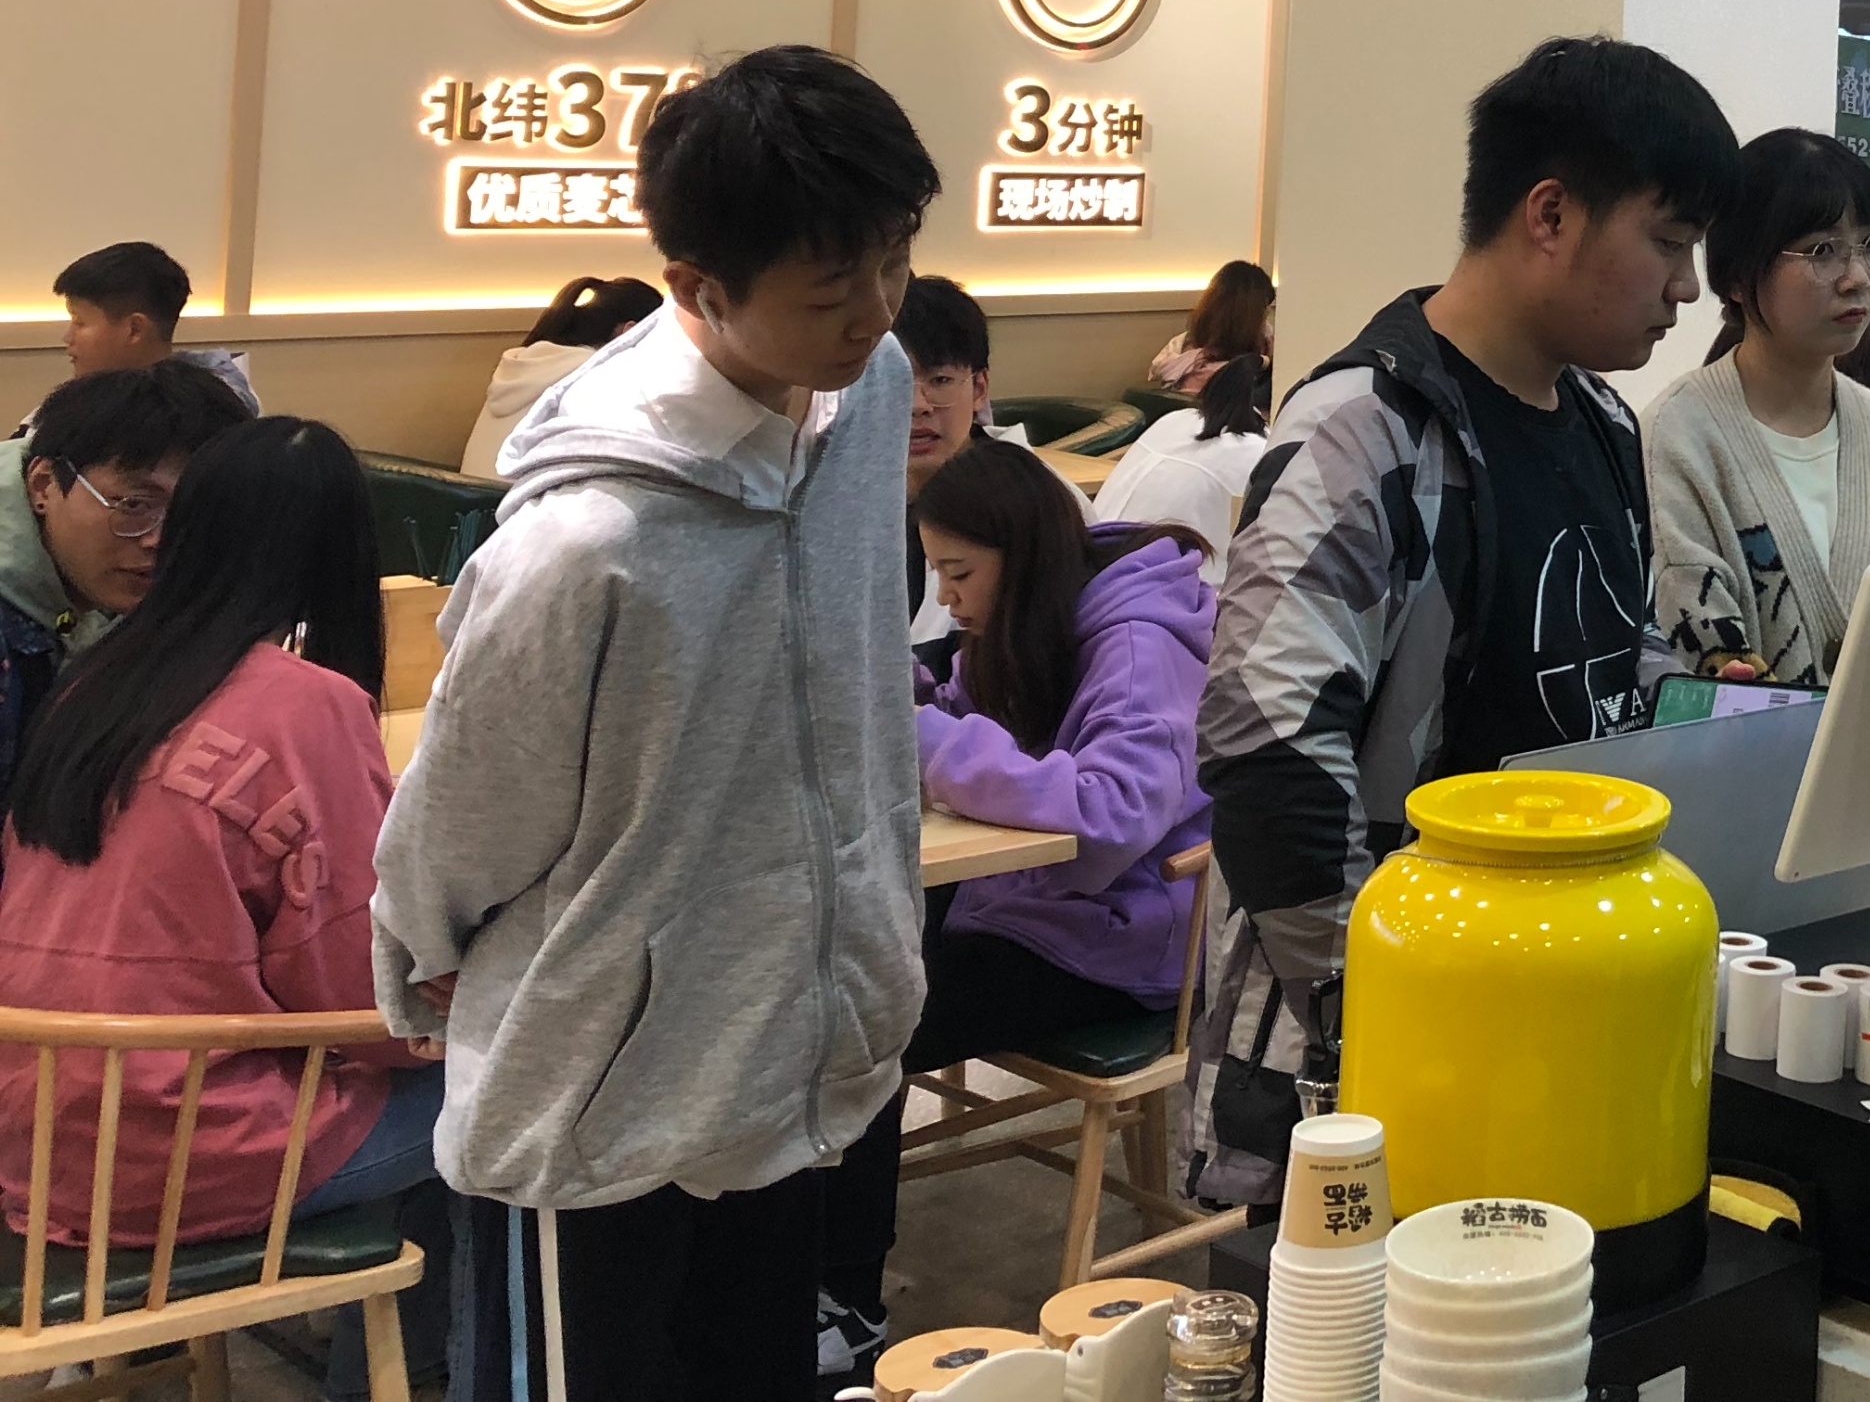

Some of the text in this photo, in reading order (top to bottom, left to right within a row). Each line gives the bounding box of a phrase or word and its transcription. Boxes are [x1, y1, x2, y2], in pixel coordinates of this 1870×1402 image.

[1006, 84, 1143, 155] 3分钟
[996, 177, 1140, 222] 现场炒制
[1460, 1201, 1548, 1228] 稻古捞面
